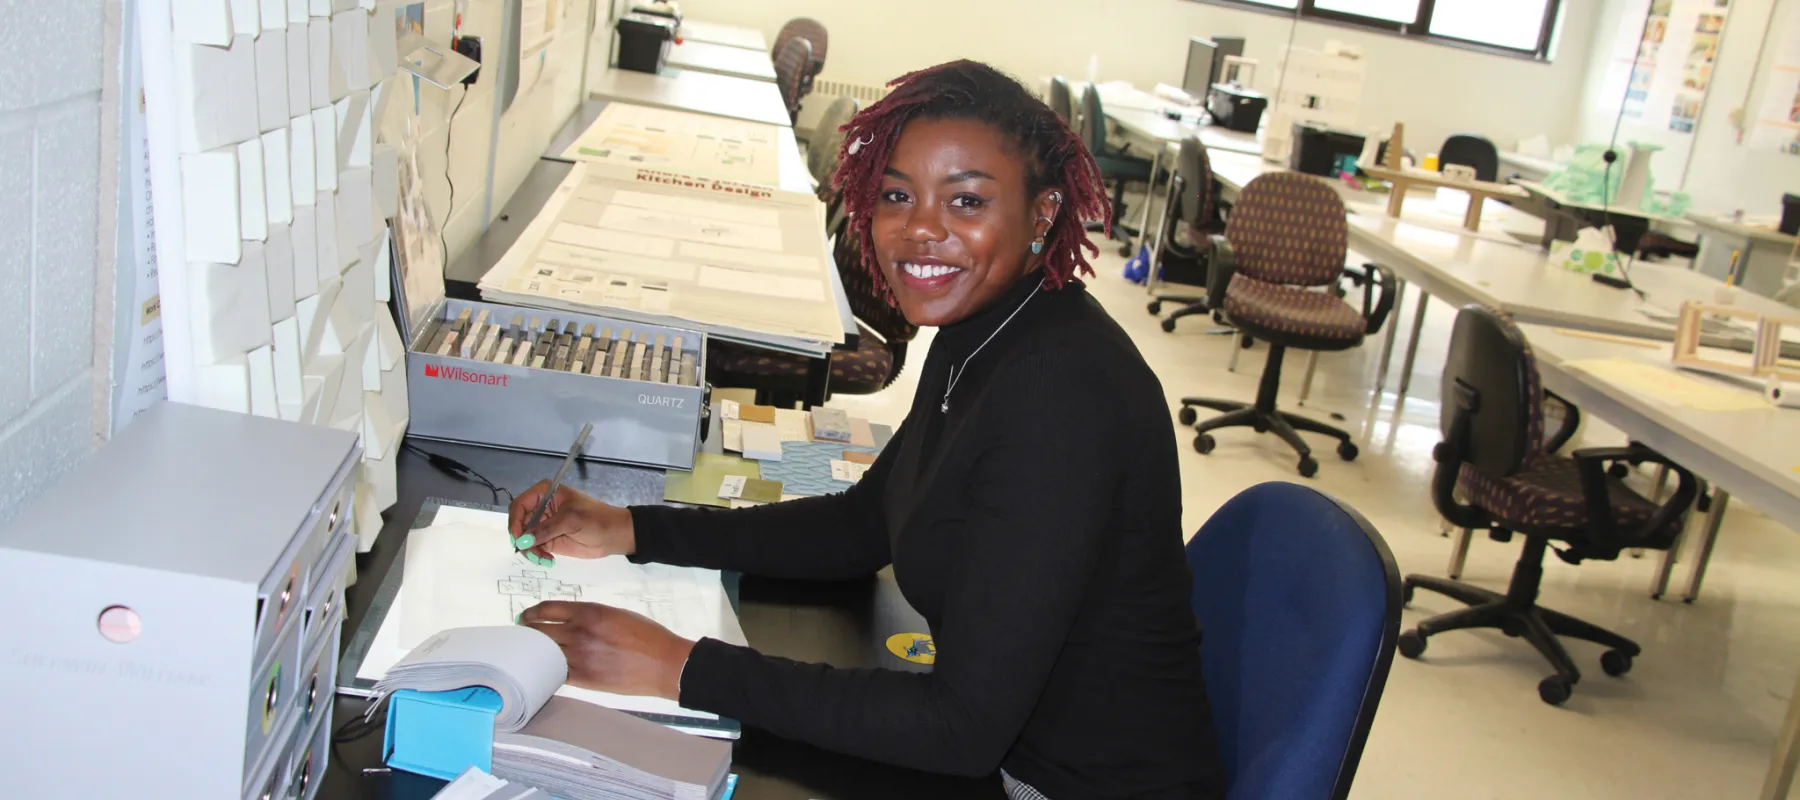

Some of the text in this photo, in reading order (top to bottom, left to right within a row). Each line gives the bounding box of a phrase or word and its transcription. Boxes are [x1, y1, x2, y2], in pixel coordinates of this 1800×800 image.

[636, 173, 705, 188] Kitchen
[711, 181, 772, 198] Design
[440, 365, 509, 387] Wilsonart
[637, 393, 685, 409] QUARTZ
